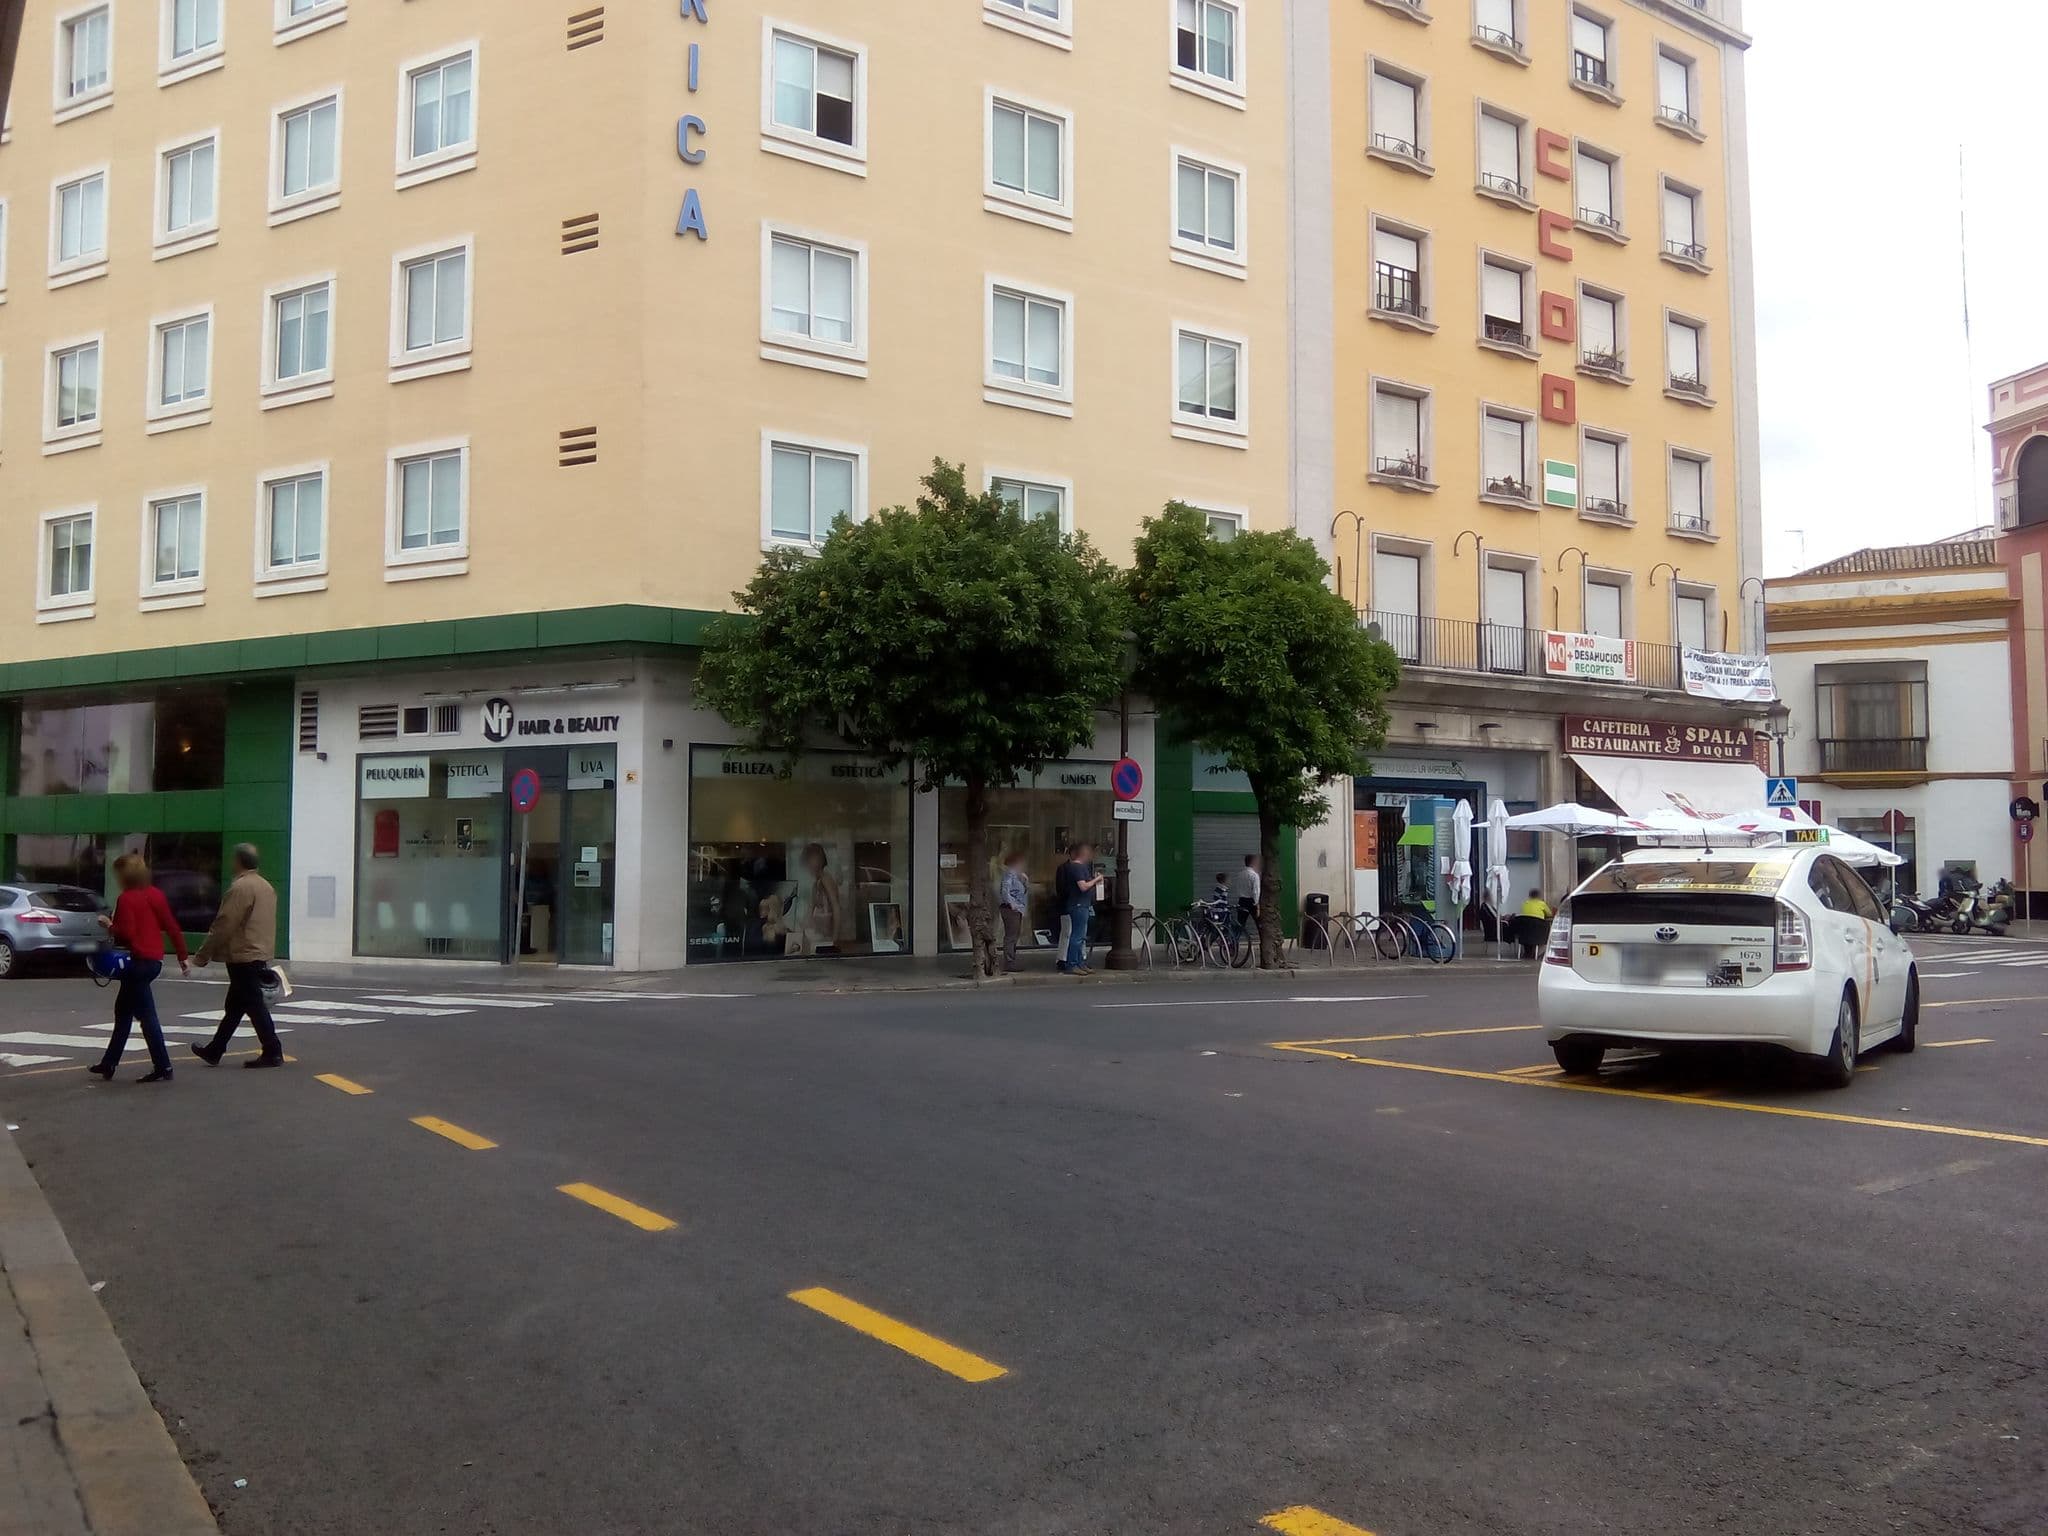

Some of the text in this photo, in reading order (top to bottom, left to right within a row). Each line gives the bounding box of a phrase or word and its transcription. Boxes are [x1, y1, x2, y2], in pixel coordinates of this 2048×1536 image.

[1537, 127, 1577, 426] CCOO
[1574, 637, 1595, 649] PARO
[1548, 641, 1565, 664] NO
[1574, 650, 1624, 664] DESAHUCIOS
[1575, 663, 1615, 676] RECORTES
[480, 702, 512, 737] Nf
[518, 715, 620, 736] HAIR & BEAUTY
[1583, 719, 1651, 737] CAFETERIA
[1684, 726, 1748, 746] SPALA
[1571, 735, 1662, 753] RESTAURANTE
[1692, 744, 1742, 758] DUQUE
[580, 760, 604, 773] UVA
[722, 761, 775, 776] BELLEZA
[1061, 773, 1097, 785] UNISEX
[1795, 829, 1819, 842] TAXI
[1589, 945, 1599, 956] D
[1739, 951, 1762, 960] 1679
